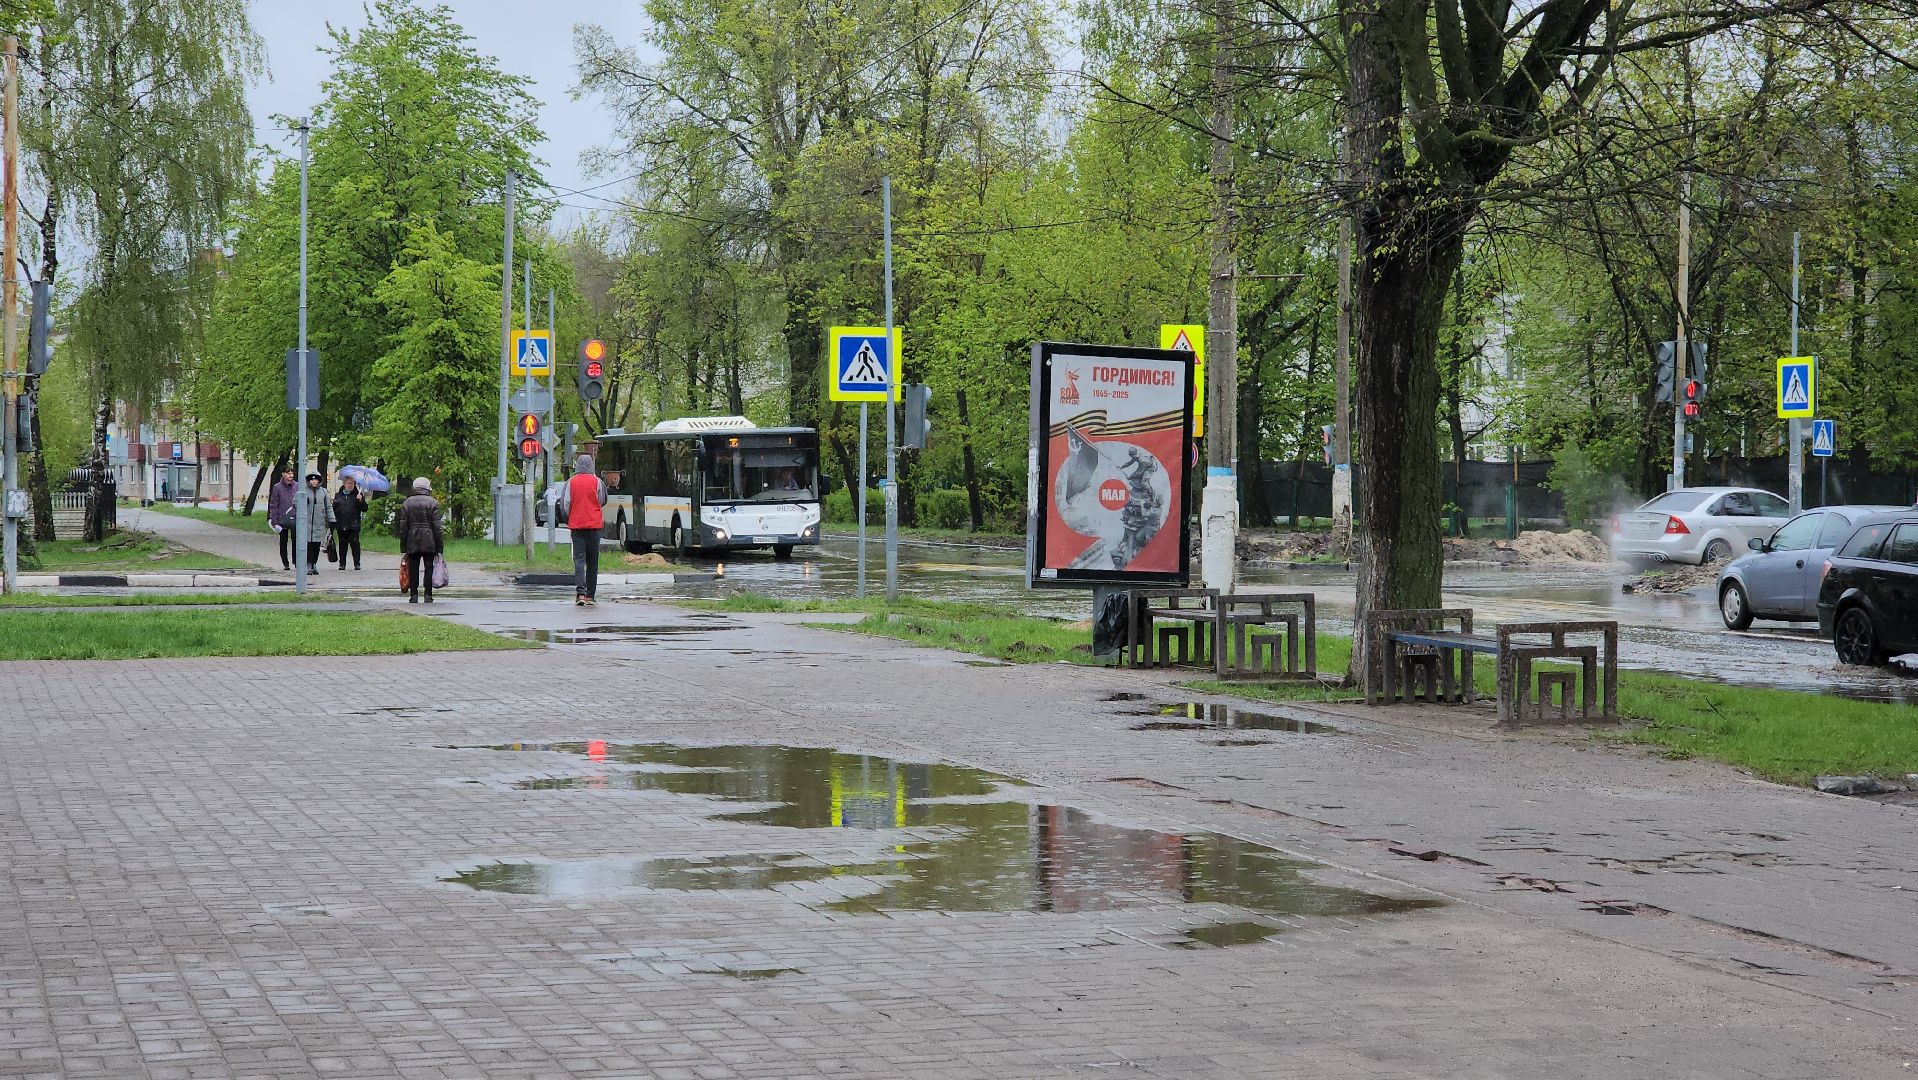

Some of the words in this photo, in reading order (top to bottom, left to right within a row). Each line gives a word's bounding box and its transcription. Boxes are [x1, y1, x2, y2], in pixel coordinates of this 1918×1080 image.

[587, 364, 602, 376] 25
[1092, 366, 1175, 386] ГОРДИМСЯ!
[1093, 389, 1129, 399] 1945-2025
[523, 440, 541, 454] 07
[1101, 489, 1126, 501] МАЯ
